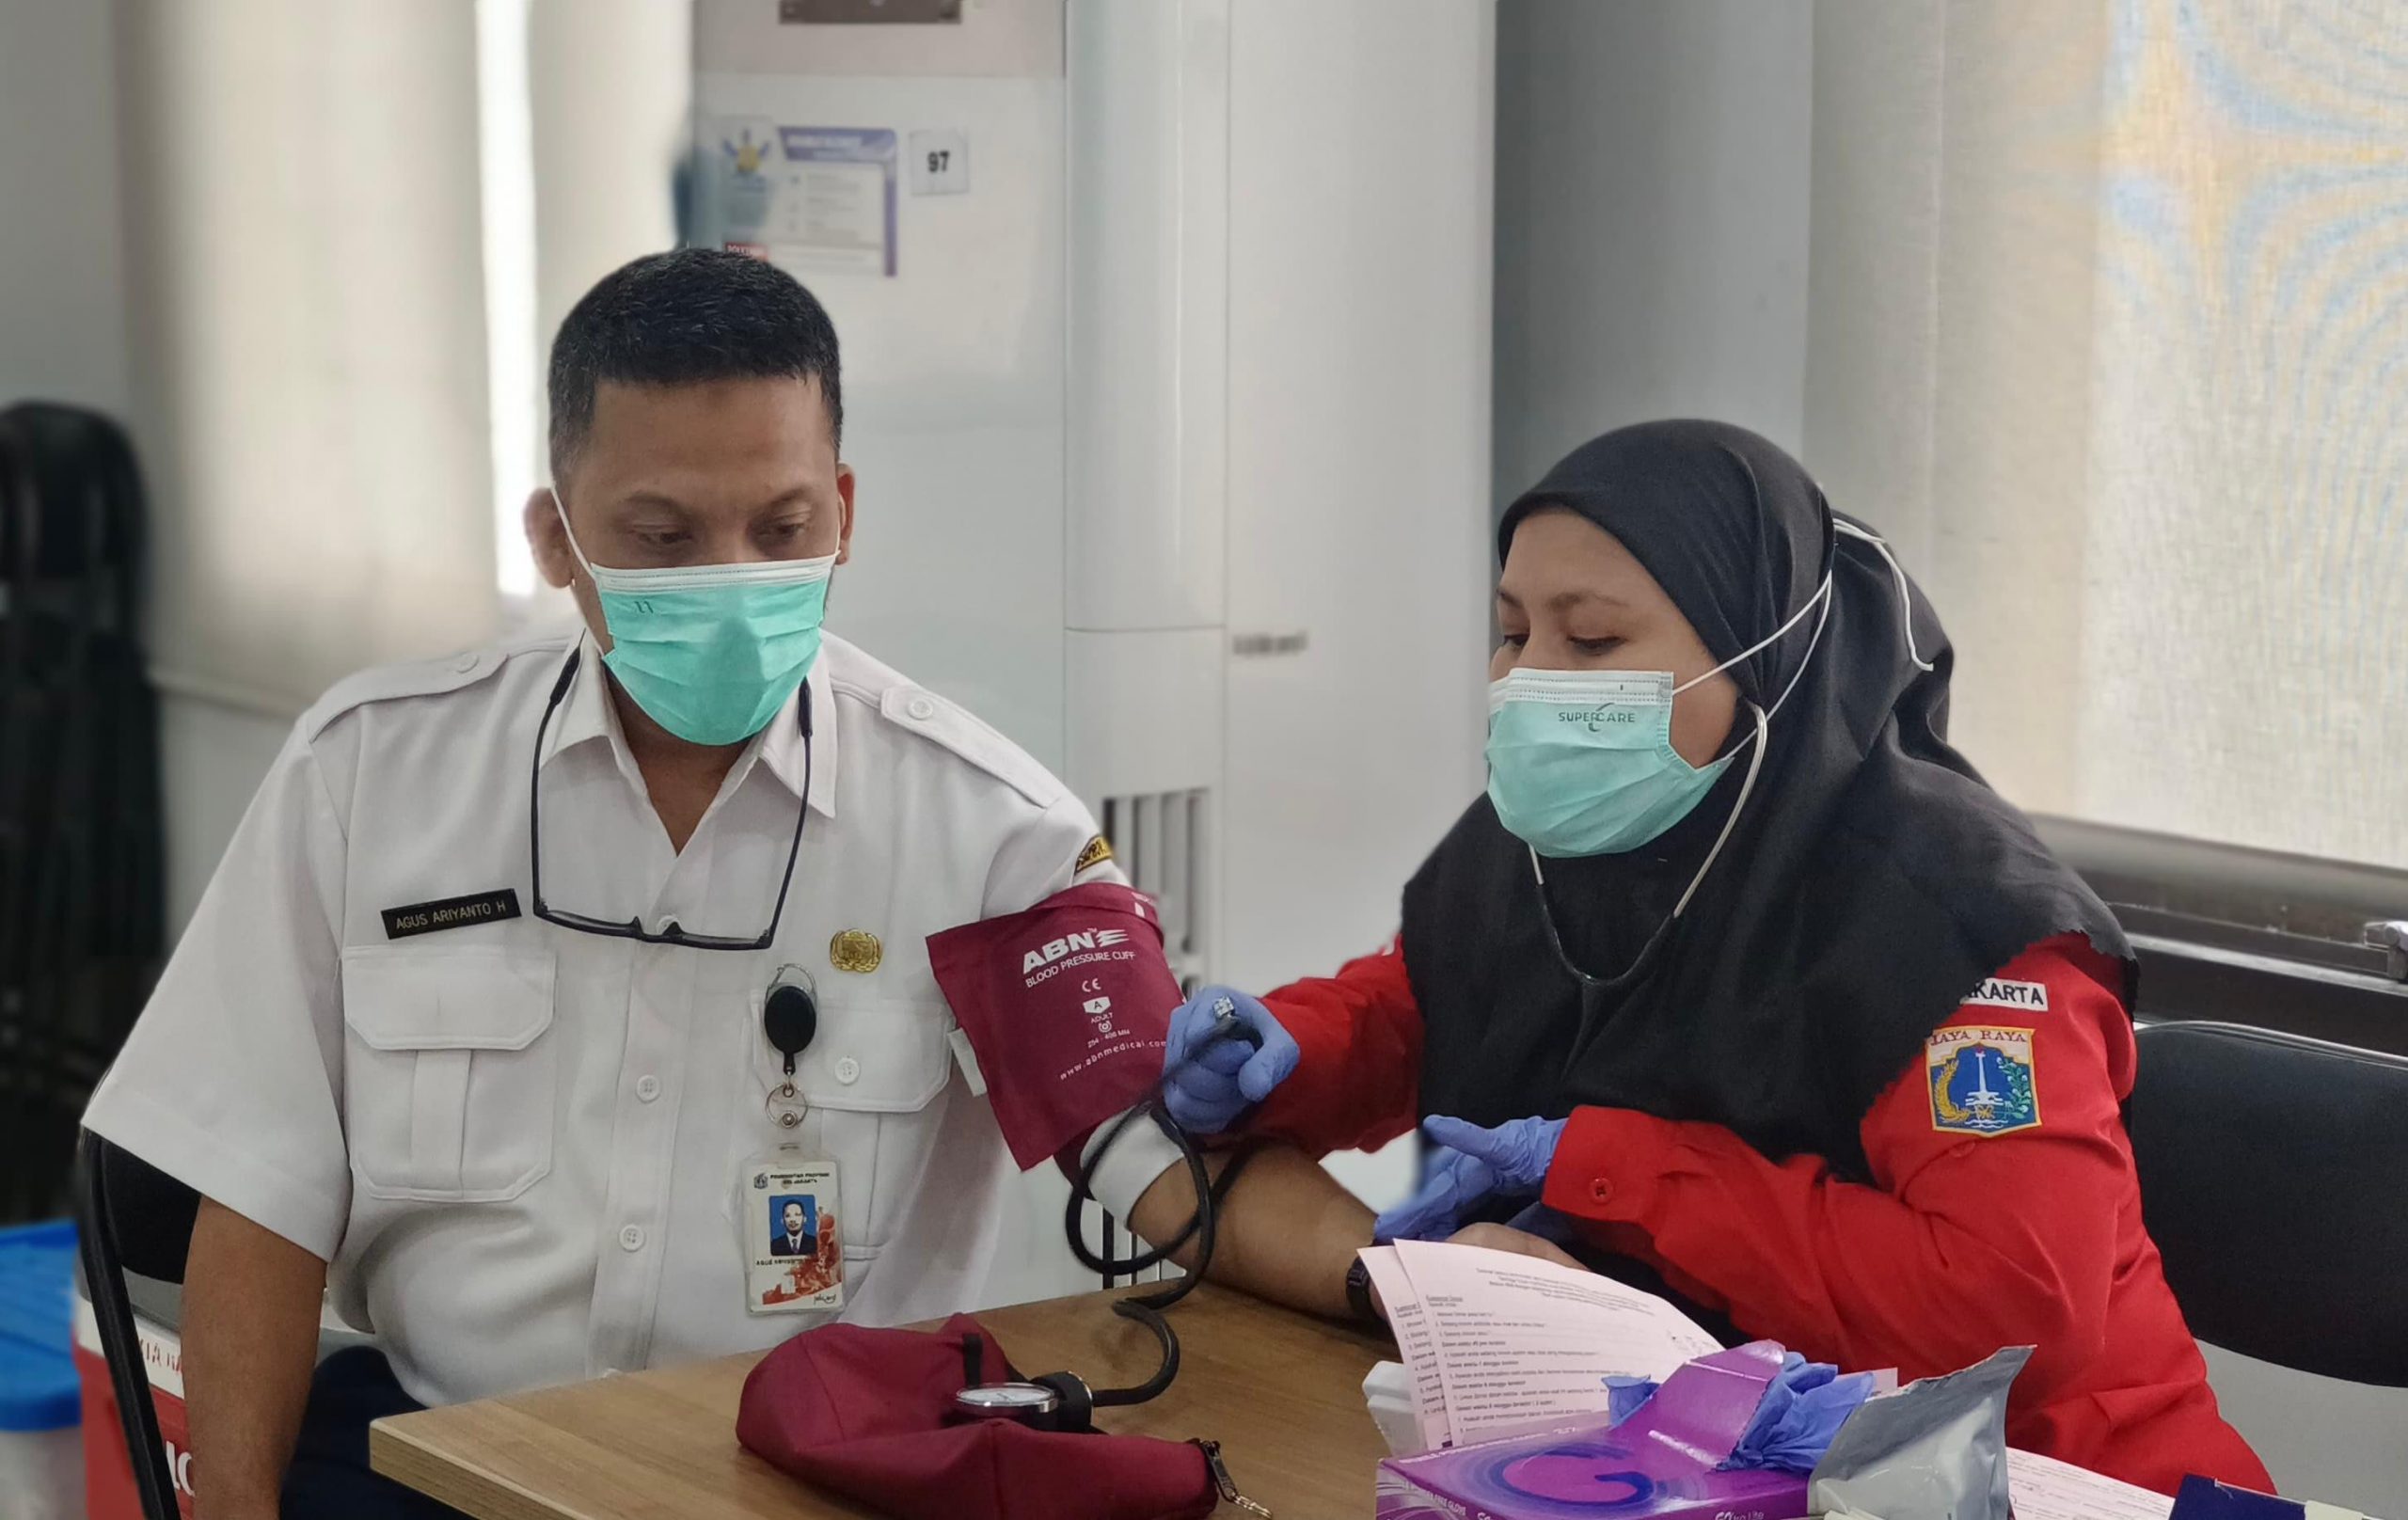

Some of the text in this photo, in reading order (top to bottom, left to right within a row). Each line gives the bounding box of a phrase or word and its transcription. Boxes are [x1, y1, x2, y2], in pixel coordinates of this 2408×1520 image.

[927, 150, 950, 173] 97
[1558, 710, 1636, 723] SUPERCARE
[395, 900, 506, 929] AGUS ARIYANTO H
[1025, 950, 1135, 989] BLOOD PRESSURE CUFF
[1968, 981, 2044, 1005] KARTA
[1094, 1000, 1102, 1010] A
[1929, 1029, 2027, 1046] JAYA RAYA
